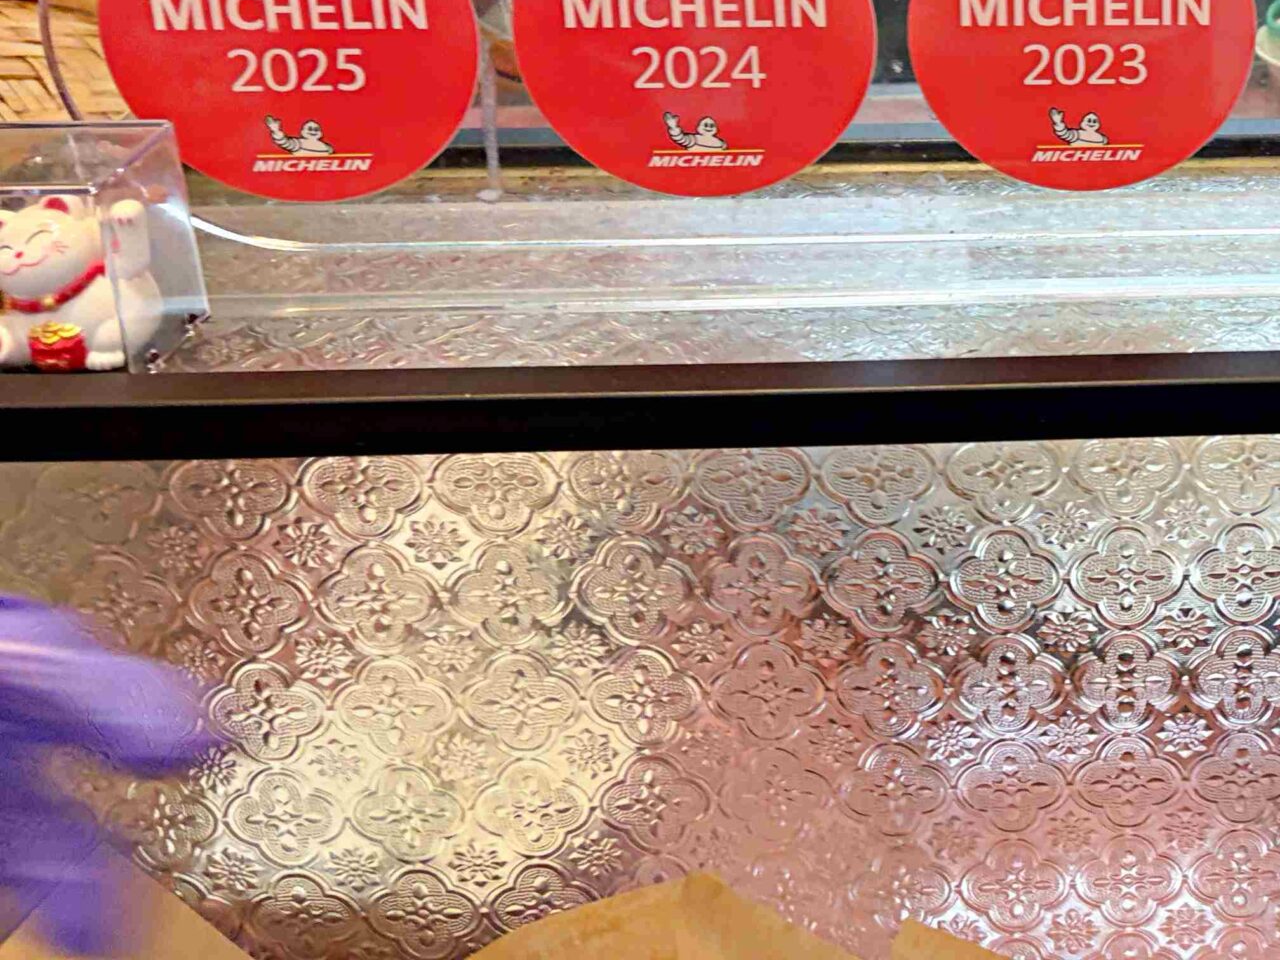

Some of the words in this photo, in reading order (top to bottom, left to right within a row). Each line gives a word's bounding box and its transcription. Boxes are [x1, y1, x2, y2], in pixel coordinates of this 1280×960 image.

[227, 47, 367, 93] 2025
[632, 45, 767, 90] 2024
[1022, 42, 1149, 87] 2023
[252, 158, 372, 173] MICHELIN
[648, 154, 764, 168] MICHELIN
[1031, 149, 1143, 162] MICHELIN
